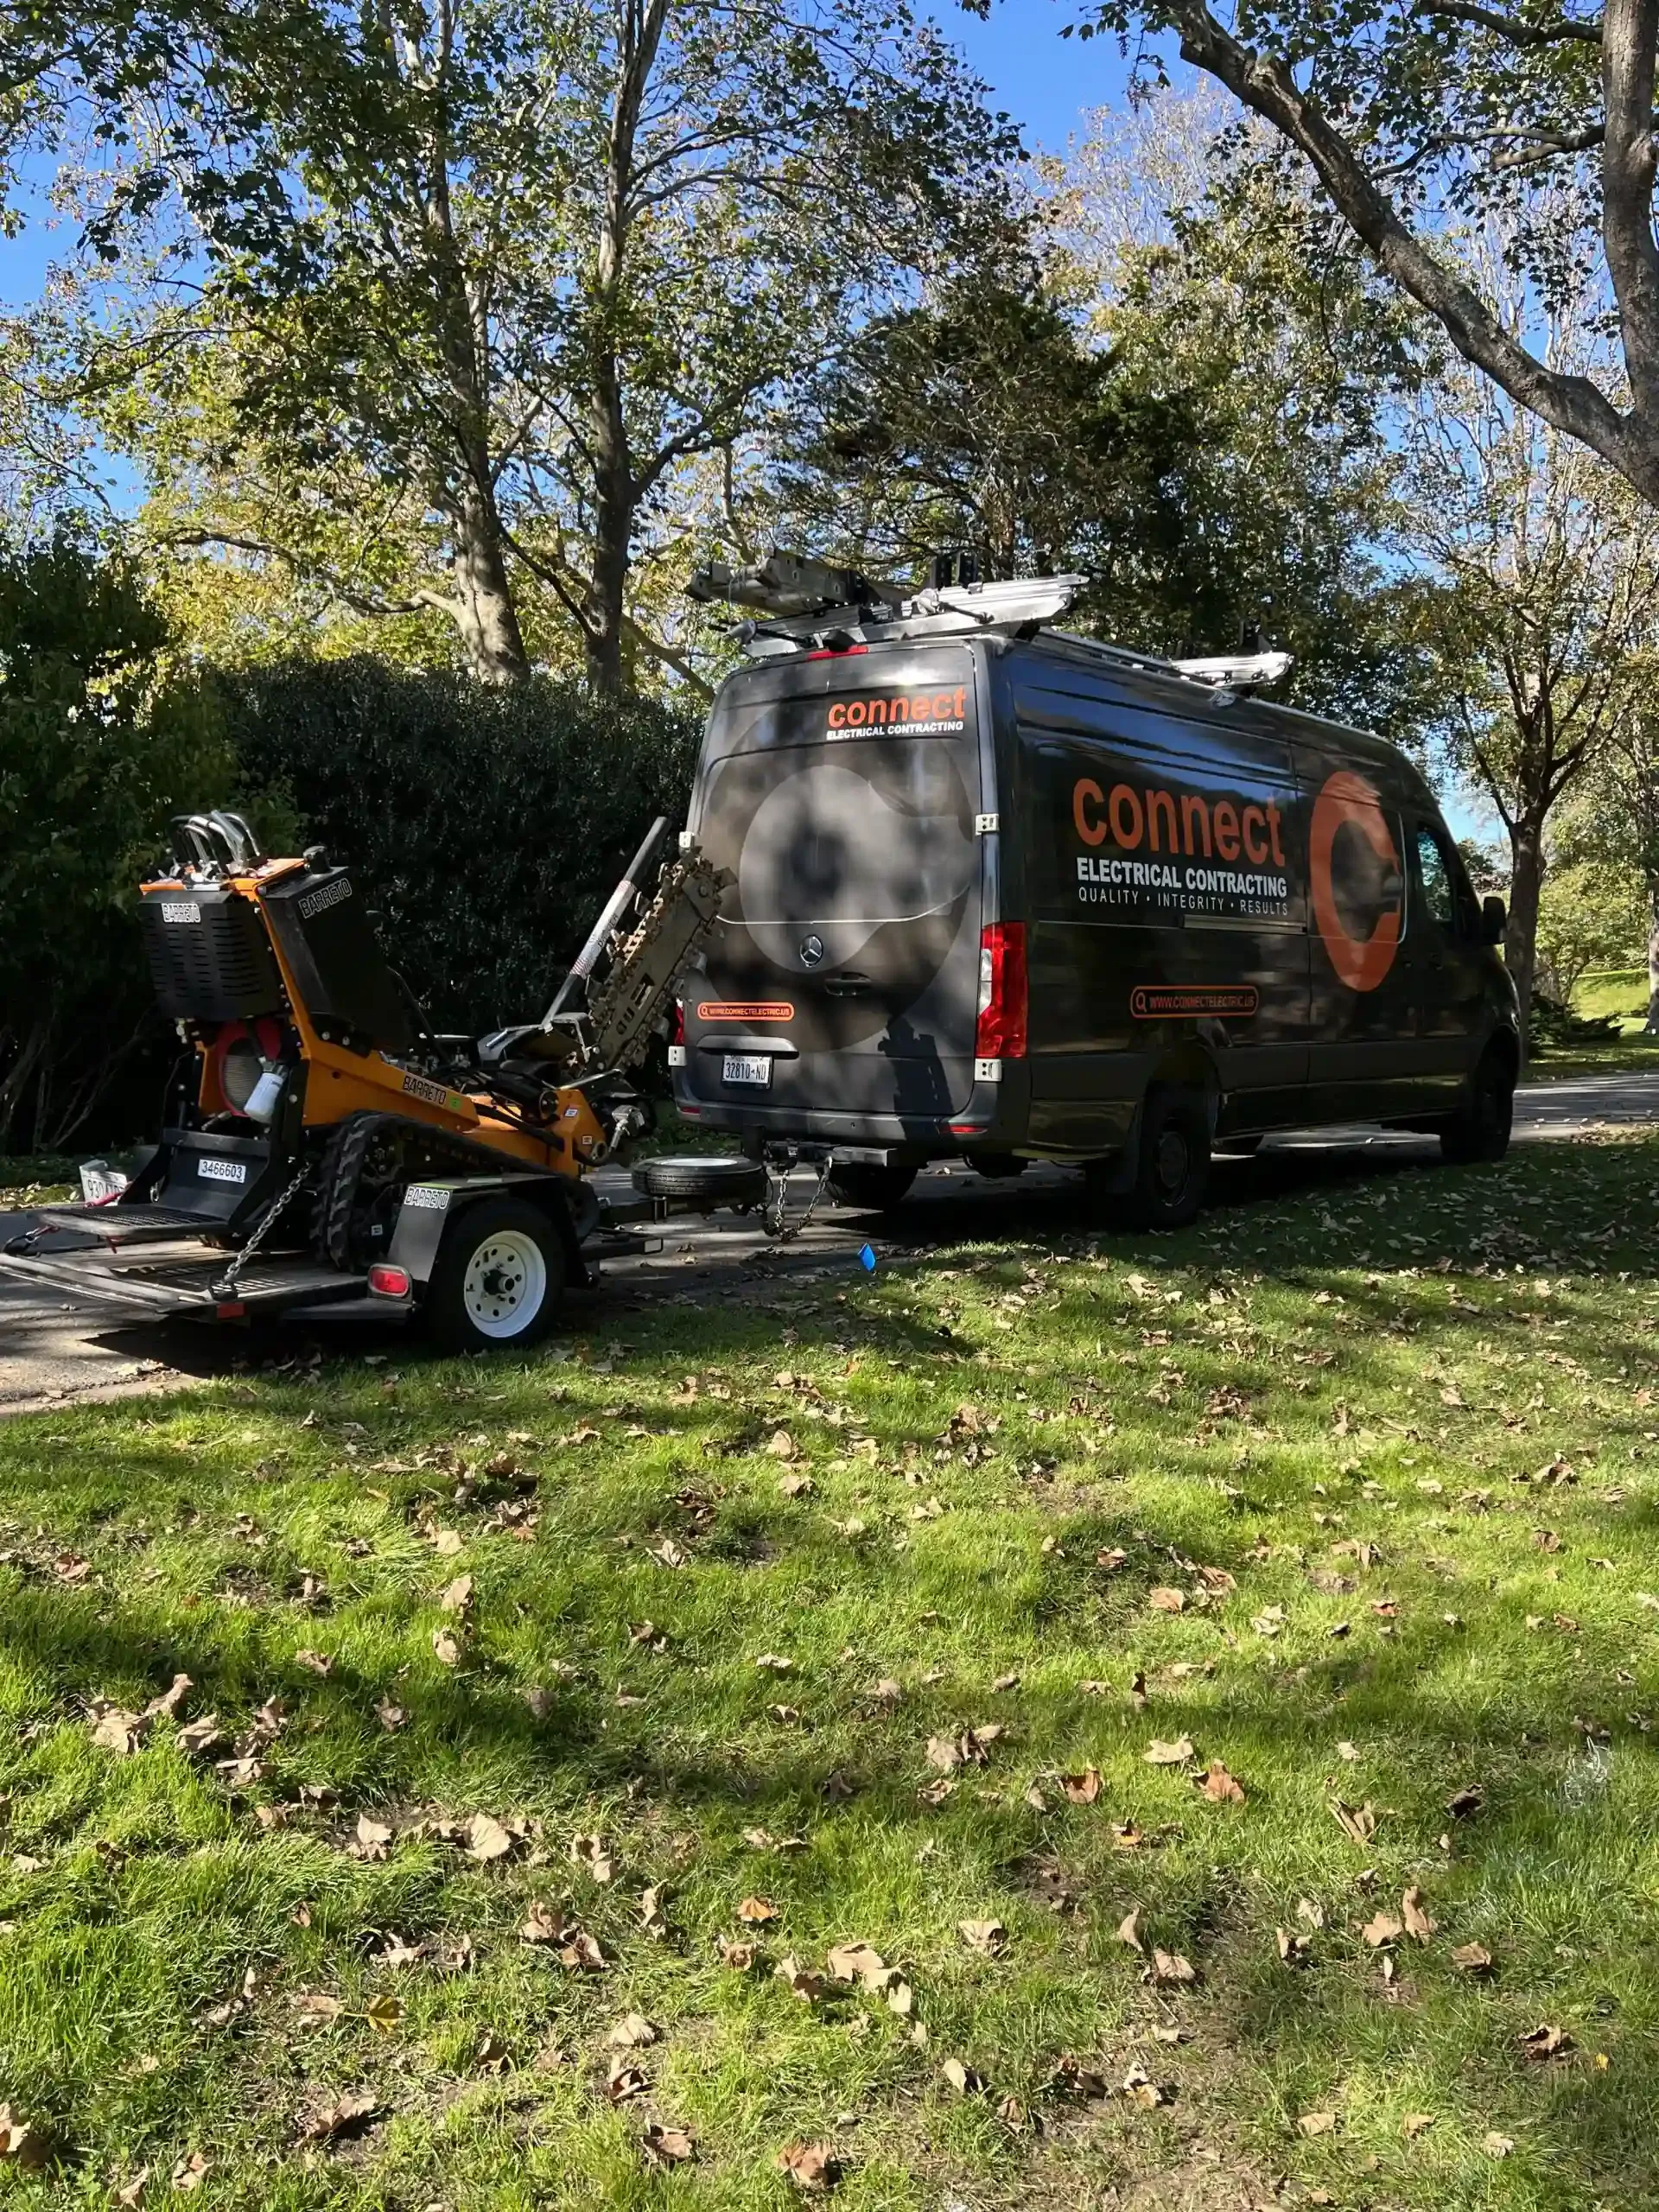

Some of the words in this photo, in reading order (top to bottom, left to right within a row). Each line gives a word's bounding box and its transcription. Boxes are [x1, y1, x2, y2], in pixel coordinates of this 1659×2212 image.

[828, 687, 967, 728] connect
[826, 726, 885, 741] ELECTRICAL
[887, 721, 963, 734] CONTRACTING
[1073, 779, 1286, 867] connect
[1077, 856, 1183, 889] ELECTRICAL
[1185, 868, 1287, 899] CONTRACTING
[298, 878, 353, 918] BARRETO
[1078, 887, 1139, 906] QUALITY
[1157, 893, 1224, 912] INTEGRITY
[1240, 899, 1288, 917] RESULTS
[403, 1076, 447, 1105] BARRETO
[201, 1160, 243, 1179] 3466603
[404, 1185, 450, 1210] BARRETO
